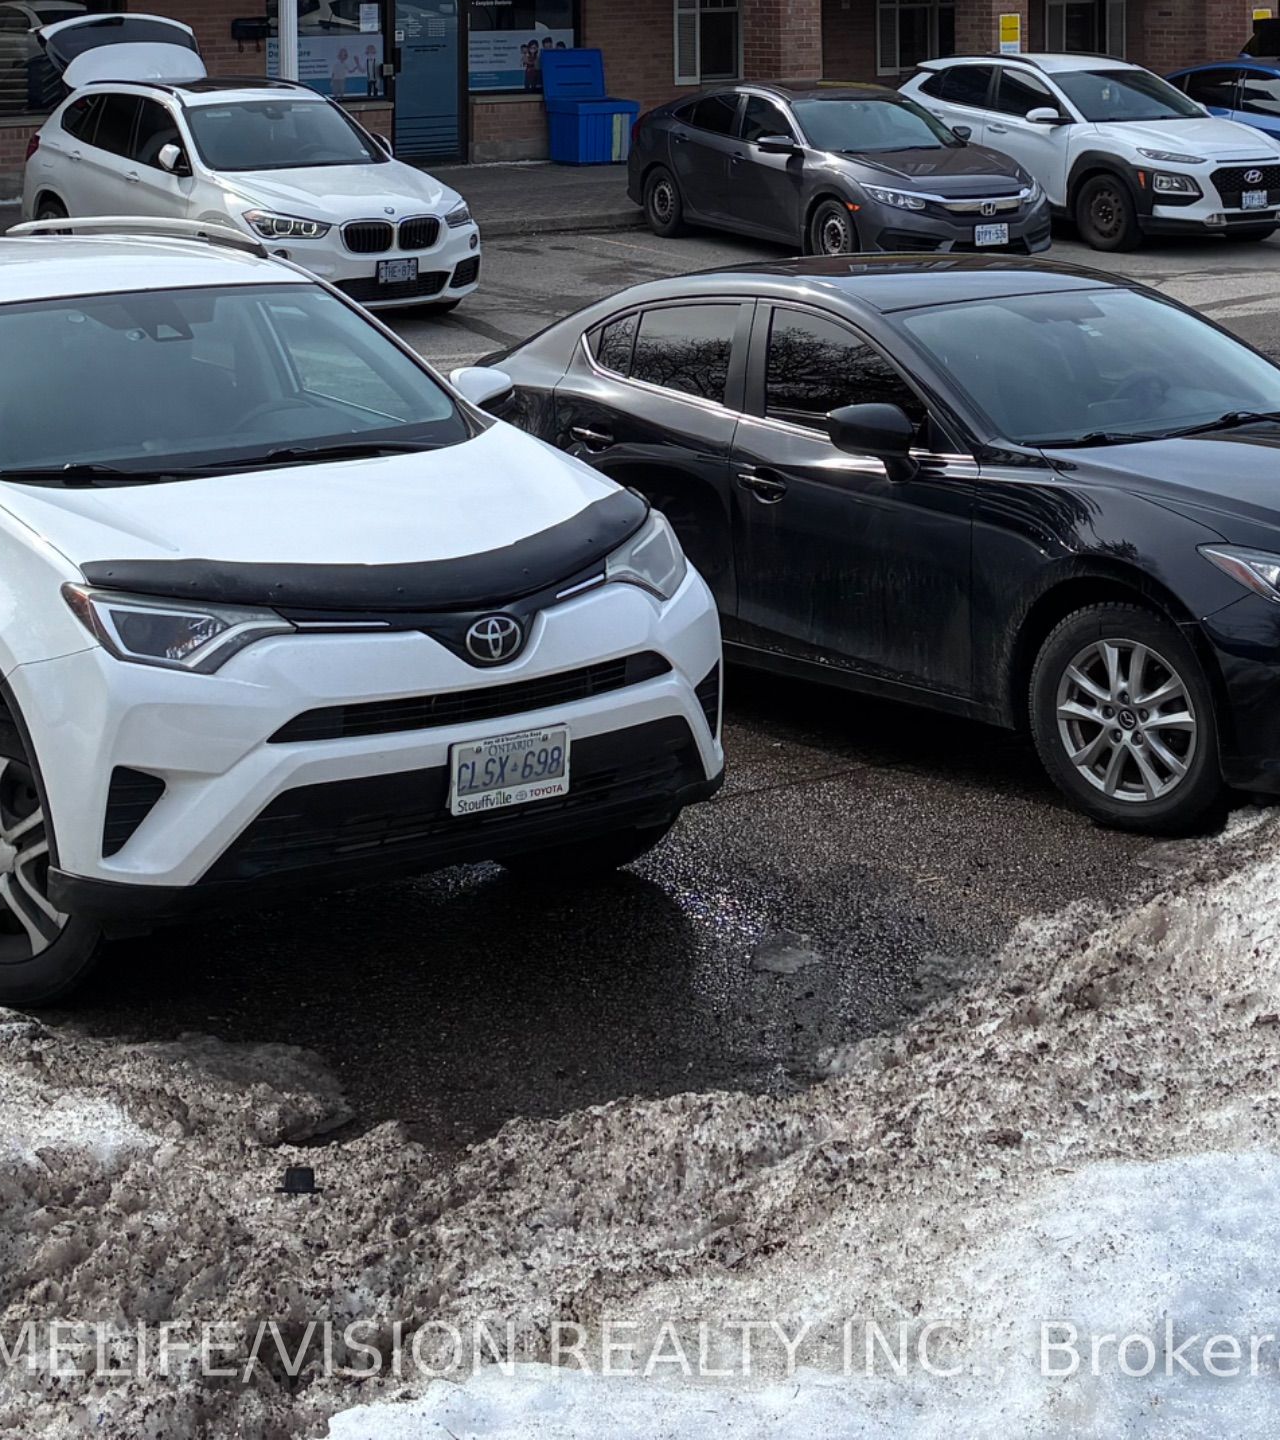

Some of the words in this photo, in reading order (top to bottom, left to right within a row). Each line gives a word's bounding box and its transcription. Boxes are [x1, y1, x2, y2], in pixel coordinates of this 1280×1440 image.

[488, 739, 534, 757] ONTARIO
[457, 790, 512, 813] Stouffville
[529, 783, 563, 798] TOYOTA
